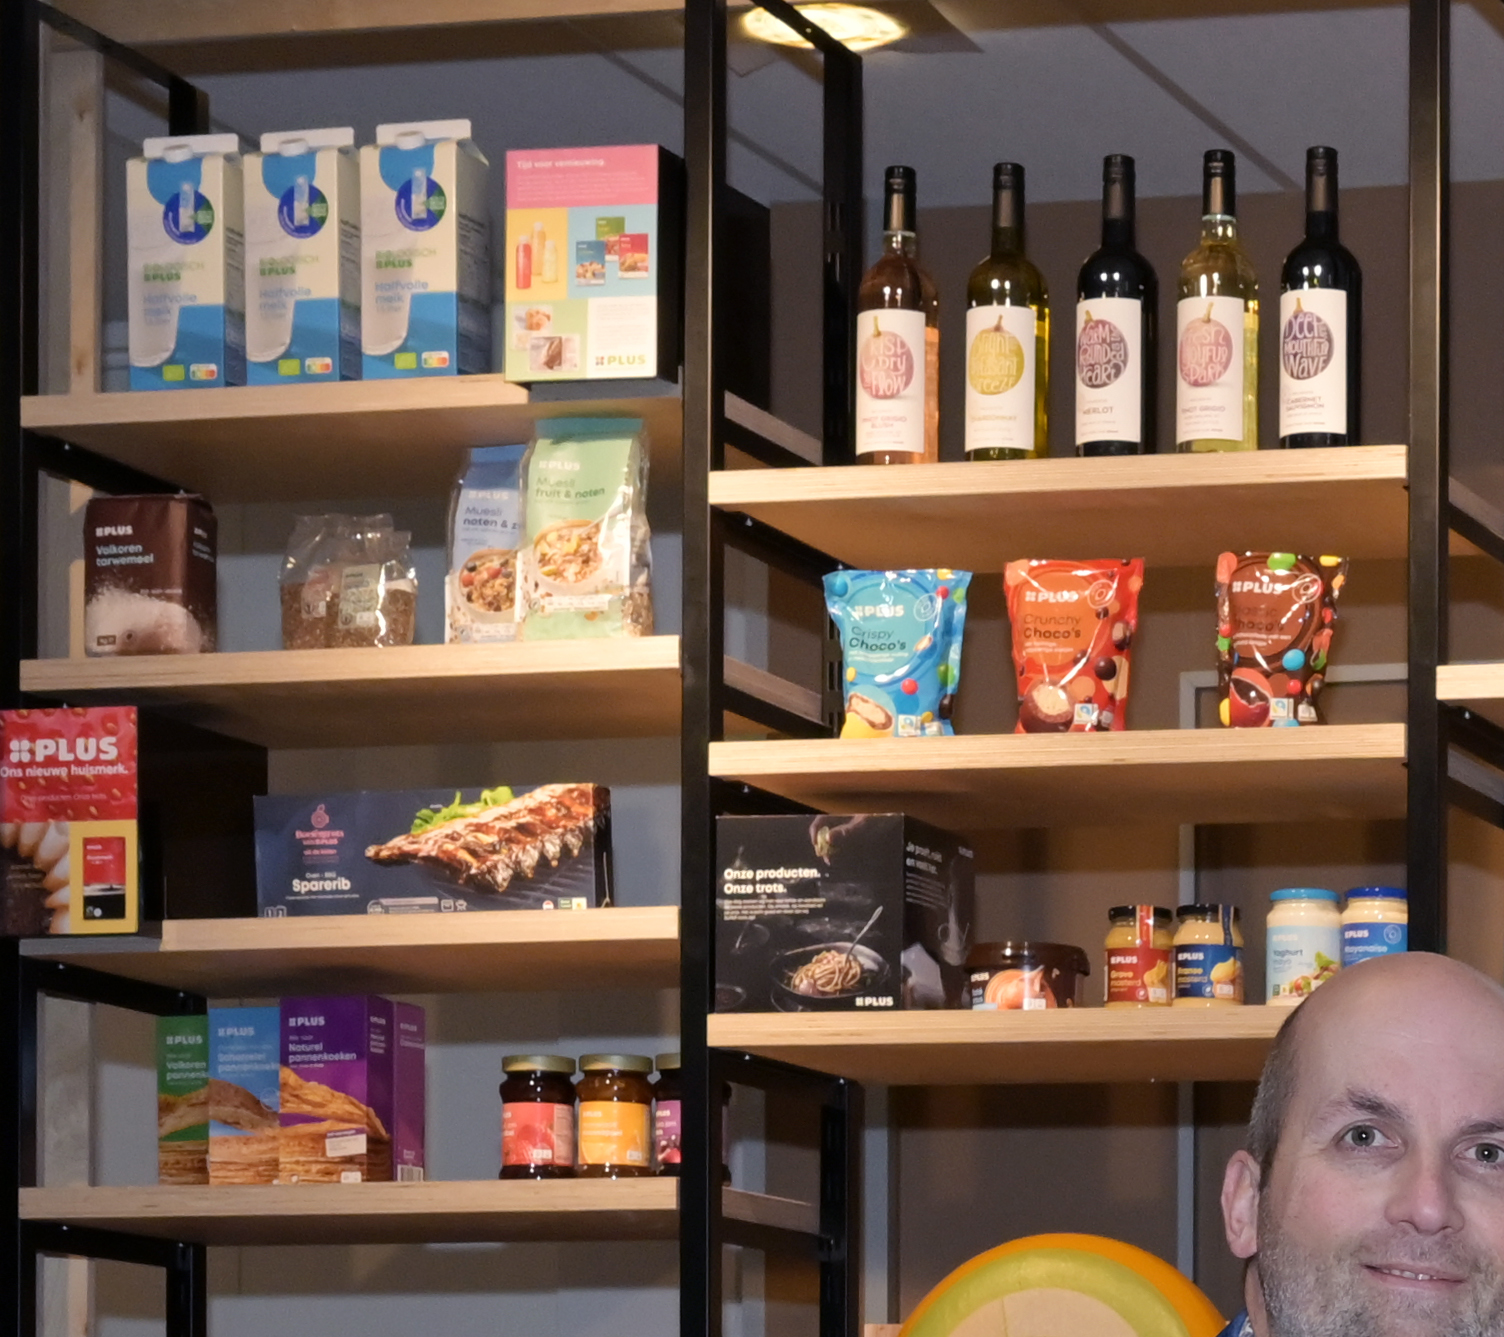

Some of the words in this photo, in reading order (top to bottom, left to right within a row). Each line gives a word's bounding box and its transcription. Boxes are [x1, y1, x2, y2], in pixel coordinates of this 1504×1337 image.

[608, 355, 646, 366] PLUS
[104, 526, 132, 535] PLUS
[1243, 582, 1283, 595] PLUS
[1037, 591, 1078, 603] PLUS
[865, 605, 904, 617] PLUS
[1024, 614, 1082, 628] Crunchy
[852, 626, 894, 641] Crispy
[1024, 626, 1081, 640] Choco's
[849, 637, 907, 652] Choco's
[36, 737, 118, 761] PLUS
[0, 768, 23, 778] Ons
[26, 765, 68, 777] nieuwe
[71, 763, 128, 775] huismerk.
[724, 868, 753, 880] Onze
[756, 867, 820, 880] producten.
[292, 878, 351, 893] Sparerib
[724, 883, 753, 894] Onze
[756, 882, 787, 893] trots.
[865, 997, 893, 1006] PLUS
[297, 1017, 325, 1026] PLUS
[175, 1036, 203, 1044] PLUS
[289, 1043, 322, 1051] Naturel
